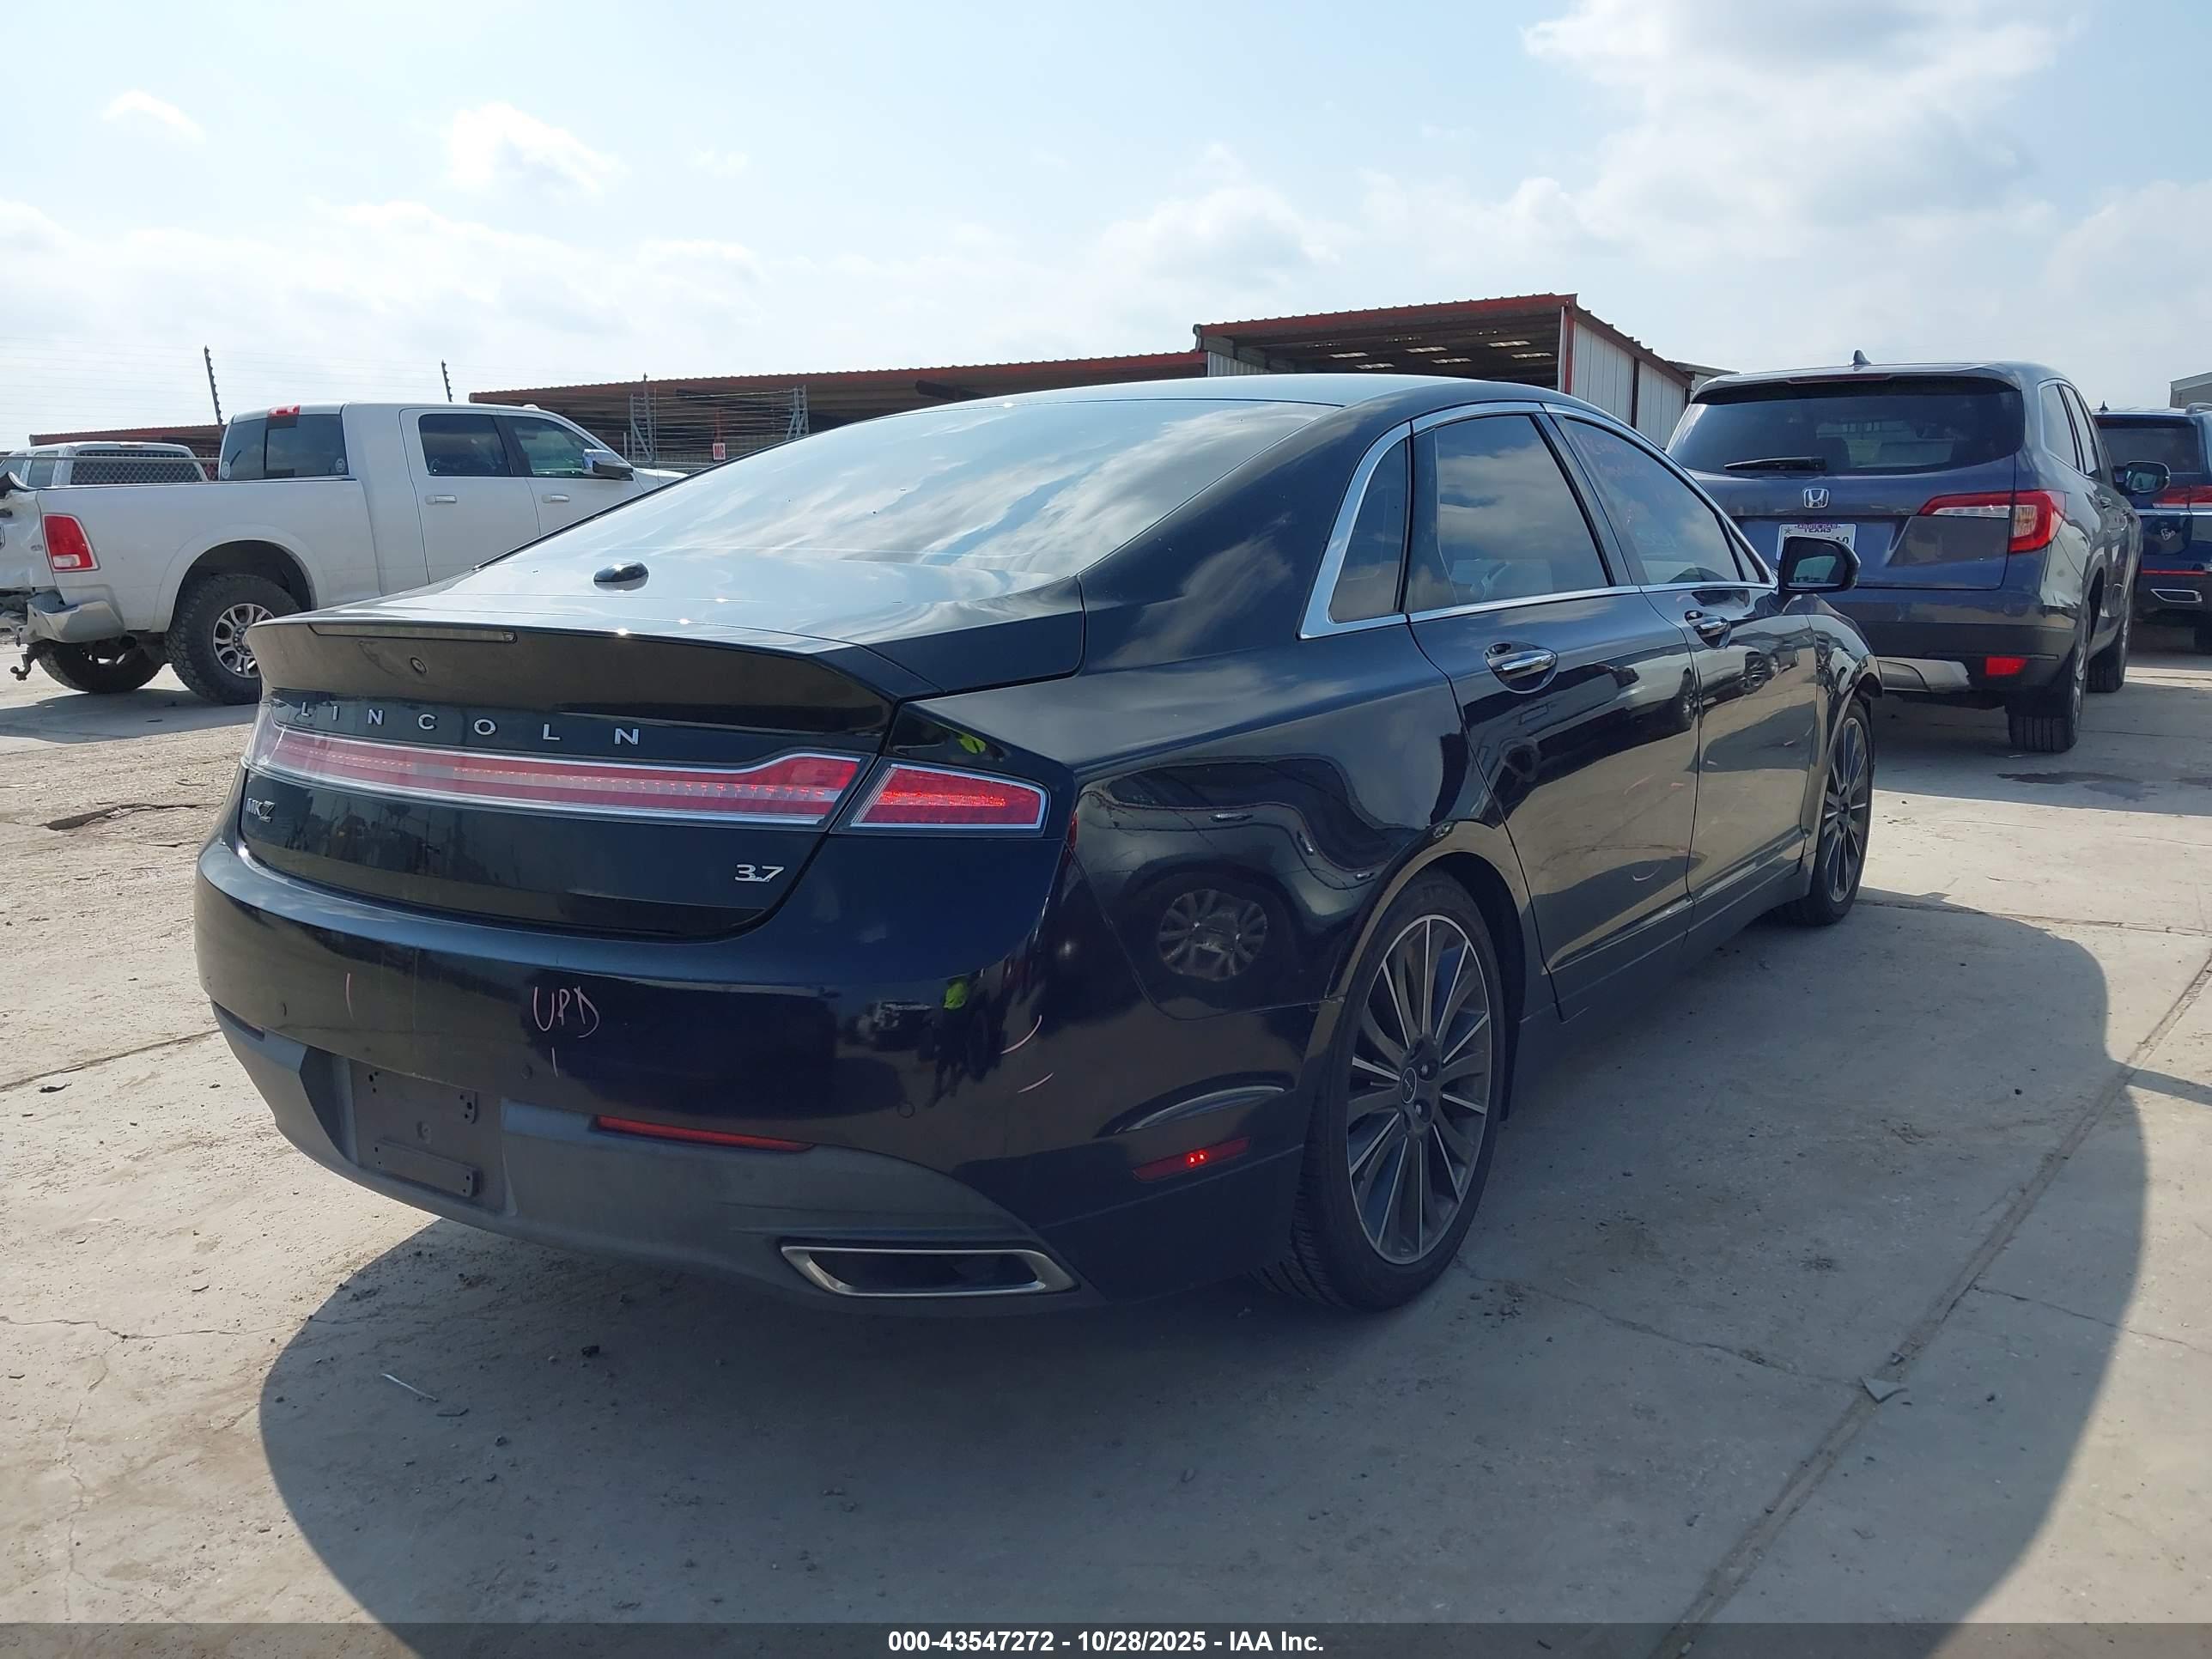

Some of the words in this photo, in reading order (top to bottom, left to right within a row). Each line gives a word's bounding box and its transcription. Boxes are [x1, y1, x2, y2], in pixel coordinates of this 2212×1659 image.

[301, 701, 640, 745] LINCOLN
[246, 798, 276, 823] MKZ
[533, 986, 599, 1038] UPD
